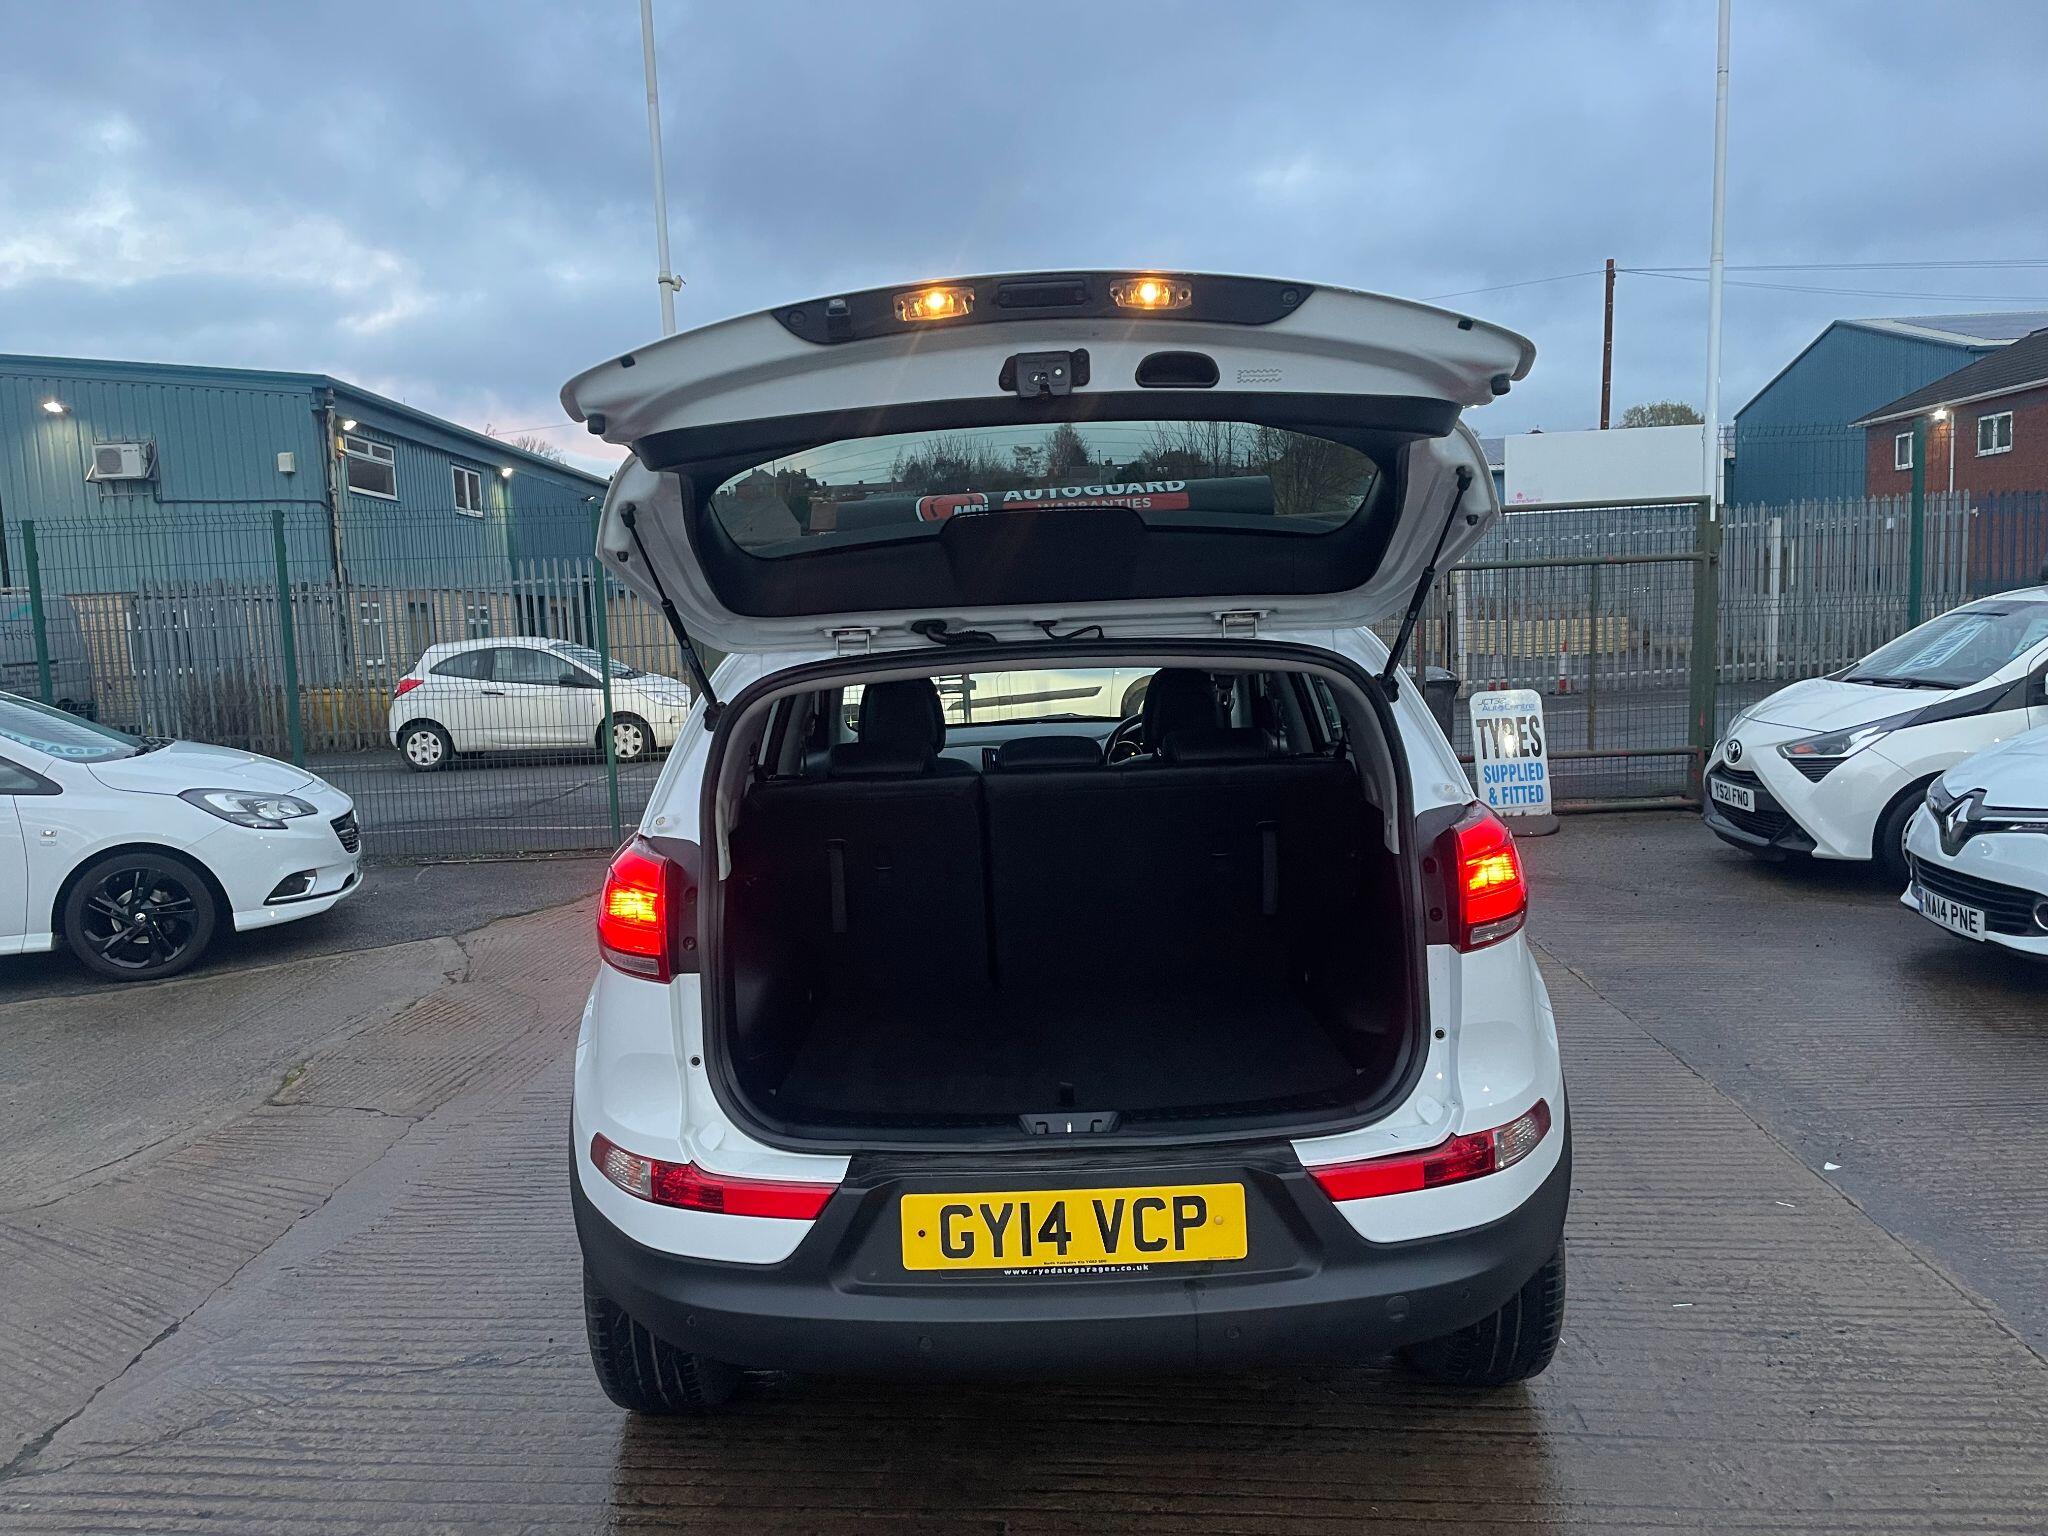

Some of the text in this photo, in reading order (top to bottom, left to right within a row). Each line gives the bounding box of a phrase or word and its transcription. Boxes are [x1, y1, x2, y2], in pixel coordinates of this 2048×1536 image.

[1003, 480, 1186, 502] AUTOGUARD
[1037, 497, 1152, 509] ANTIES
[1475, 715, 1543, 760] TYRES
[1483, 762, 1544, 784] SUPPLIED
[1488, 784, 1544, 806] & FITTED
[1715, 782, 1749, 806] YS21 FNO
[1924, 892, 1978, 933] NA14 PNE
[939, 1195, 1208, 1259] GY14 VCP
[1003, 1264, 1150, 1276] www.ryedalegarages.co.uk
